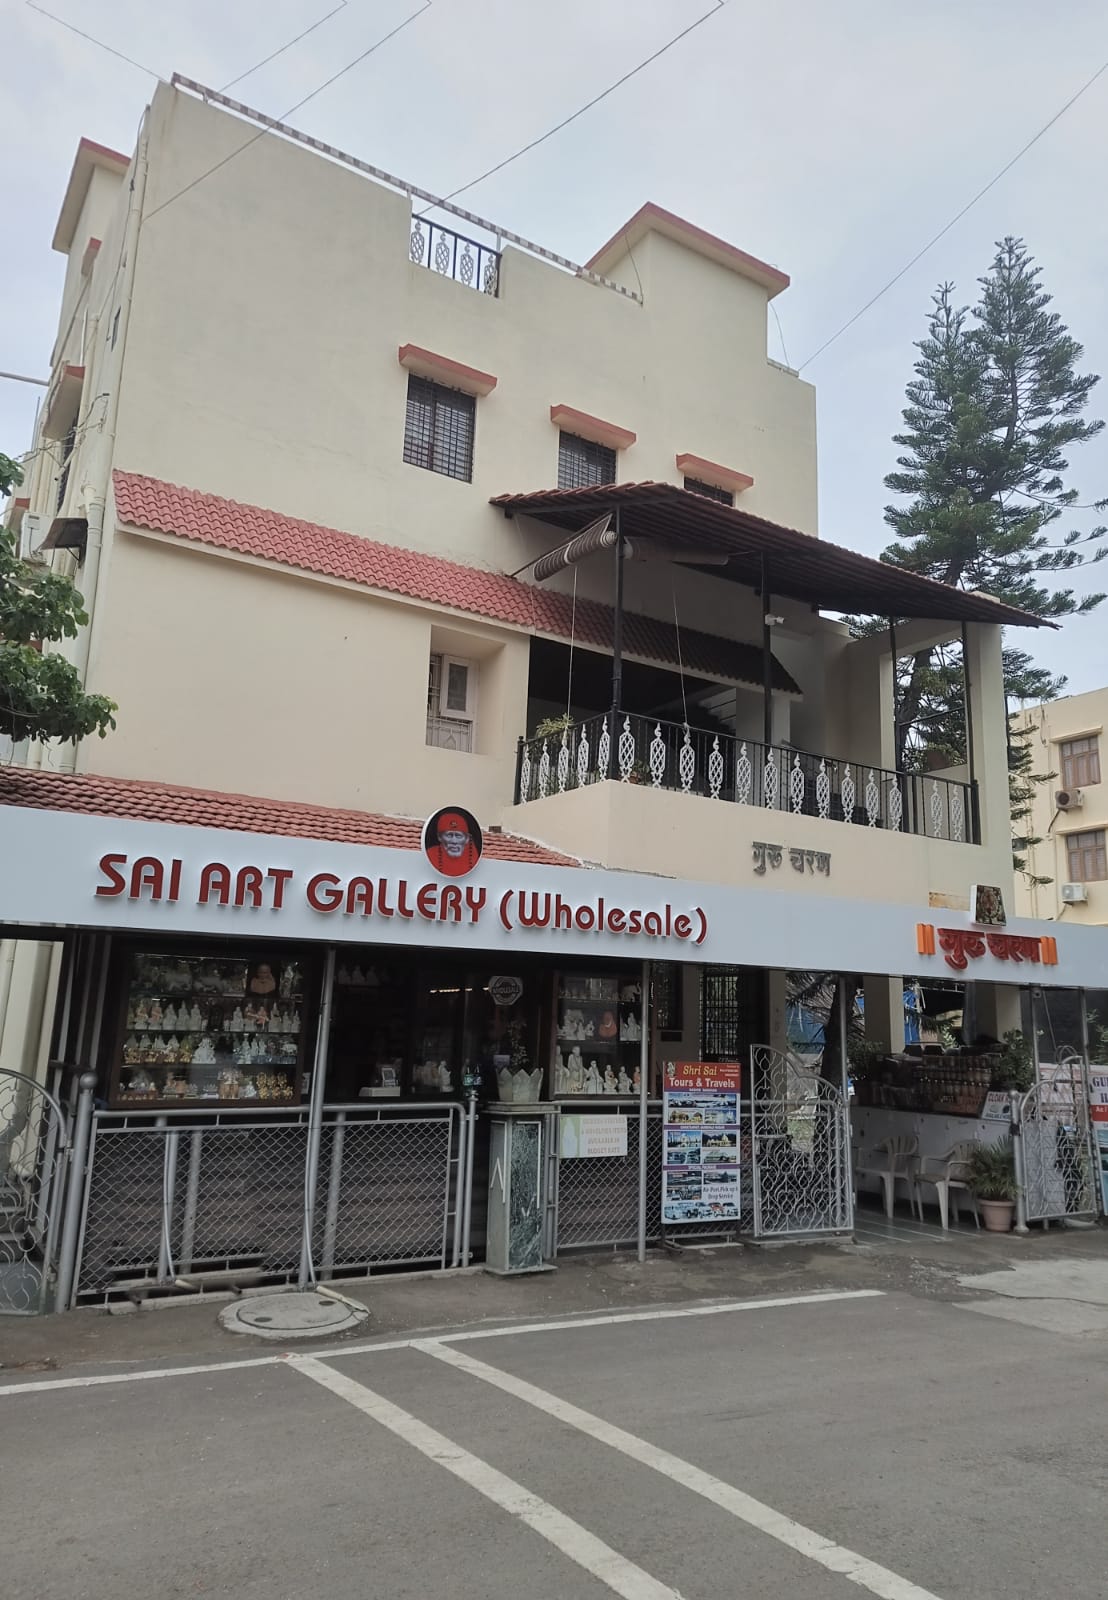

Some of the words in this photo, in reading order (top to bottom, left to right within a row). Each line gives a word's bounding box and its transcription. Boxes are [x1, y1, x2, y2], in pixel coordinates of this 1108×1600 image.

[789, 847, 831, 877] चरण
[95, 853, 183, 901] SAI
[197, 862, 294, 908] ART
[306, 873, 487, 923] GALLERY
[499, 889, 708, 945] (Wholesale)
[683, 1064, 701, 1075] Shri
[703, 1065, 718, 1076] Sai
[669, 1077, 694, 1087] Tours
[696, 1077, 703, 1087] &
[705, 1078, 735, 1088] Travels
